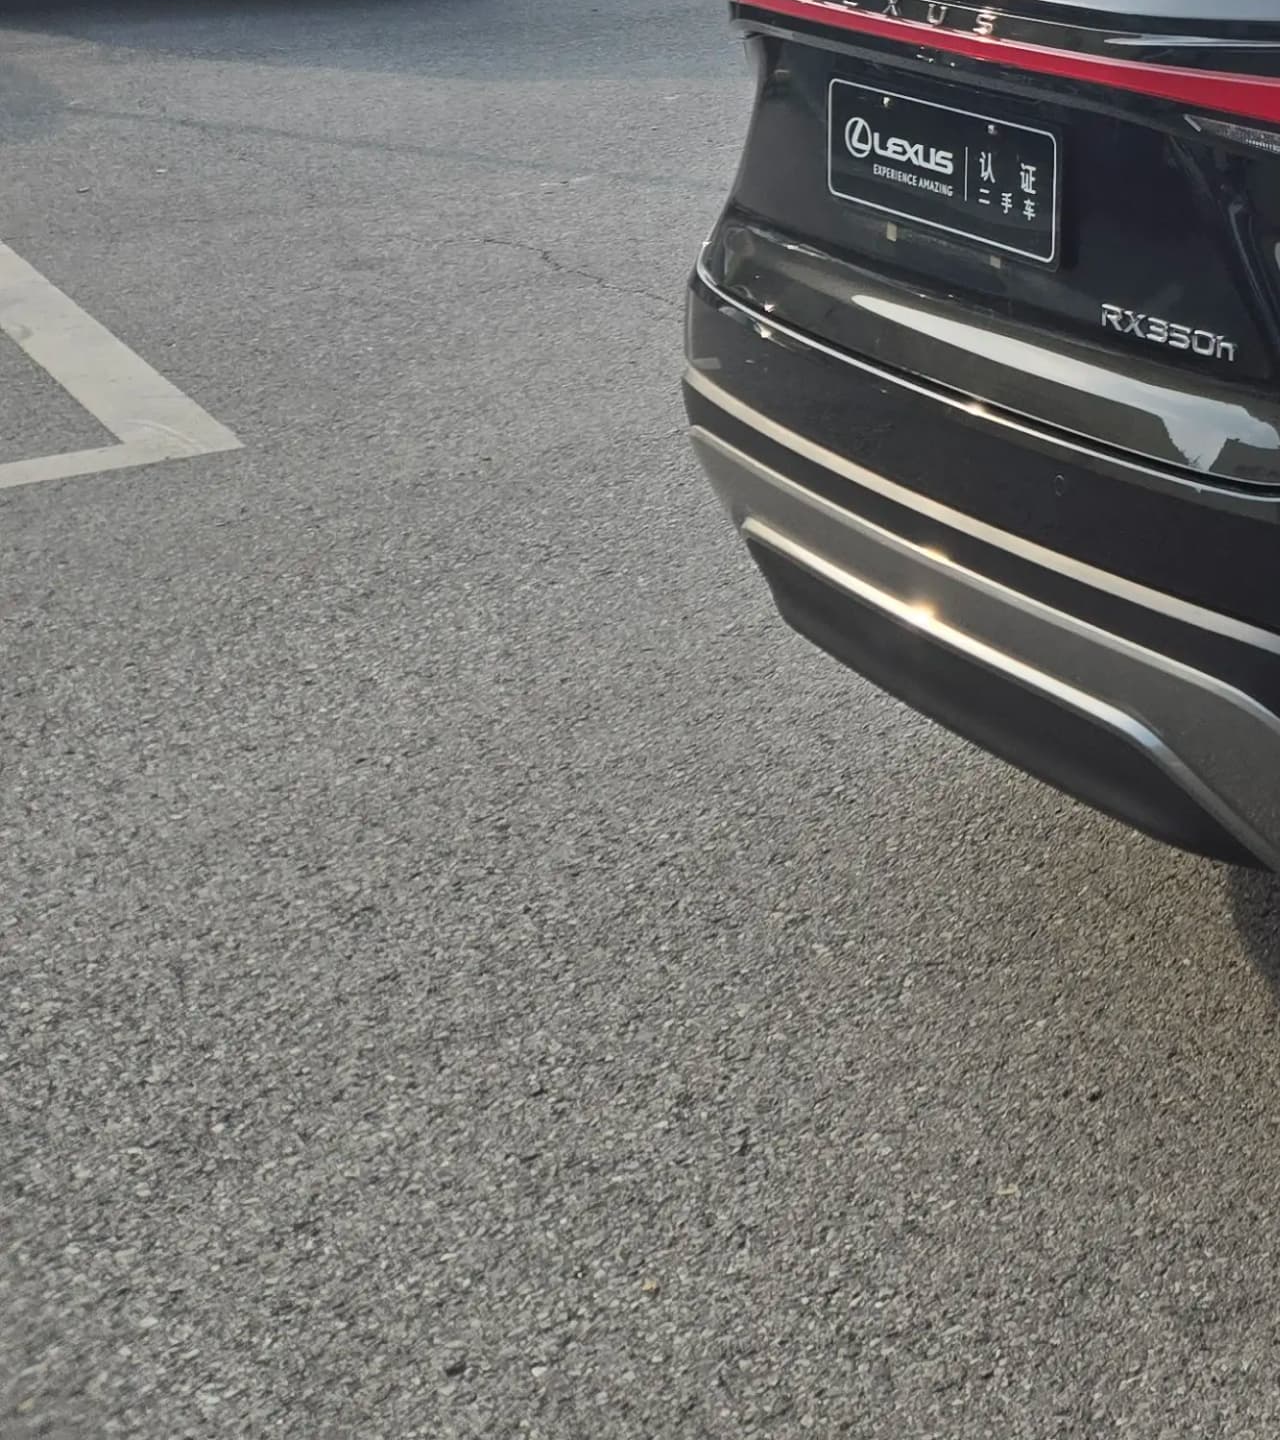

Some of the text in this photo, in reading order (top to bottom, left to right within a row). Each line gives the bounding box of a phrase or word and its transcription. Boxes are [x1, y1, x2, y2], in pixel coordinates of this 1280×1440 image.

[873, 131, 954, 175] LEXUS
[978, 151, 1037, 195] 认证
[873, 163, 954, 197] EXPERIENCE AMAZING
[978, 188, 1036, 221] 二手车
[1101, 303, 1237, 362] RX350h
